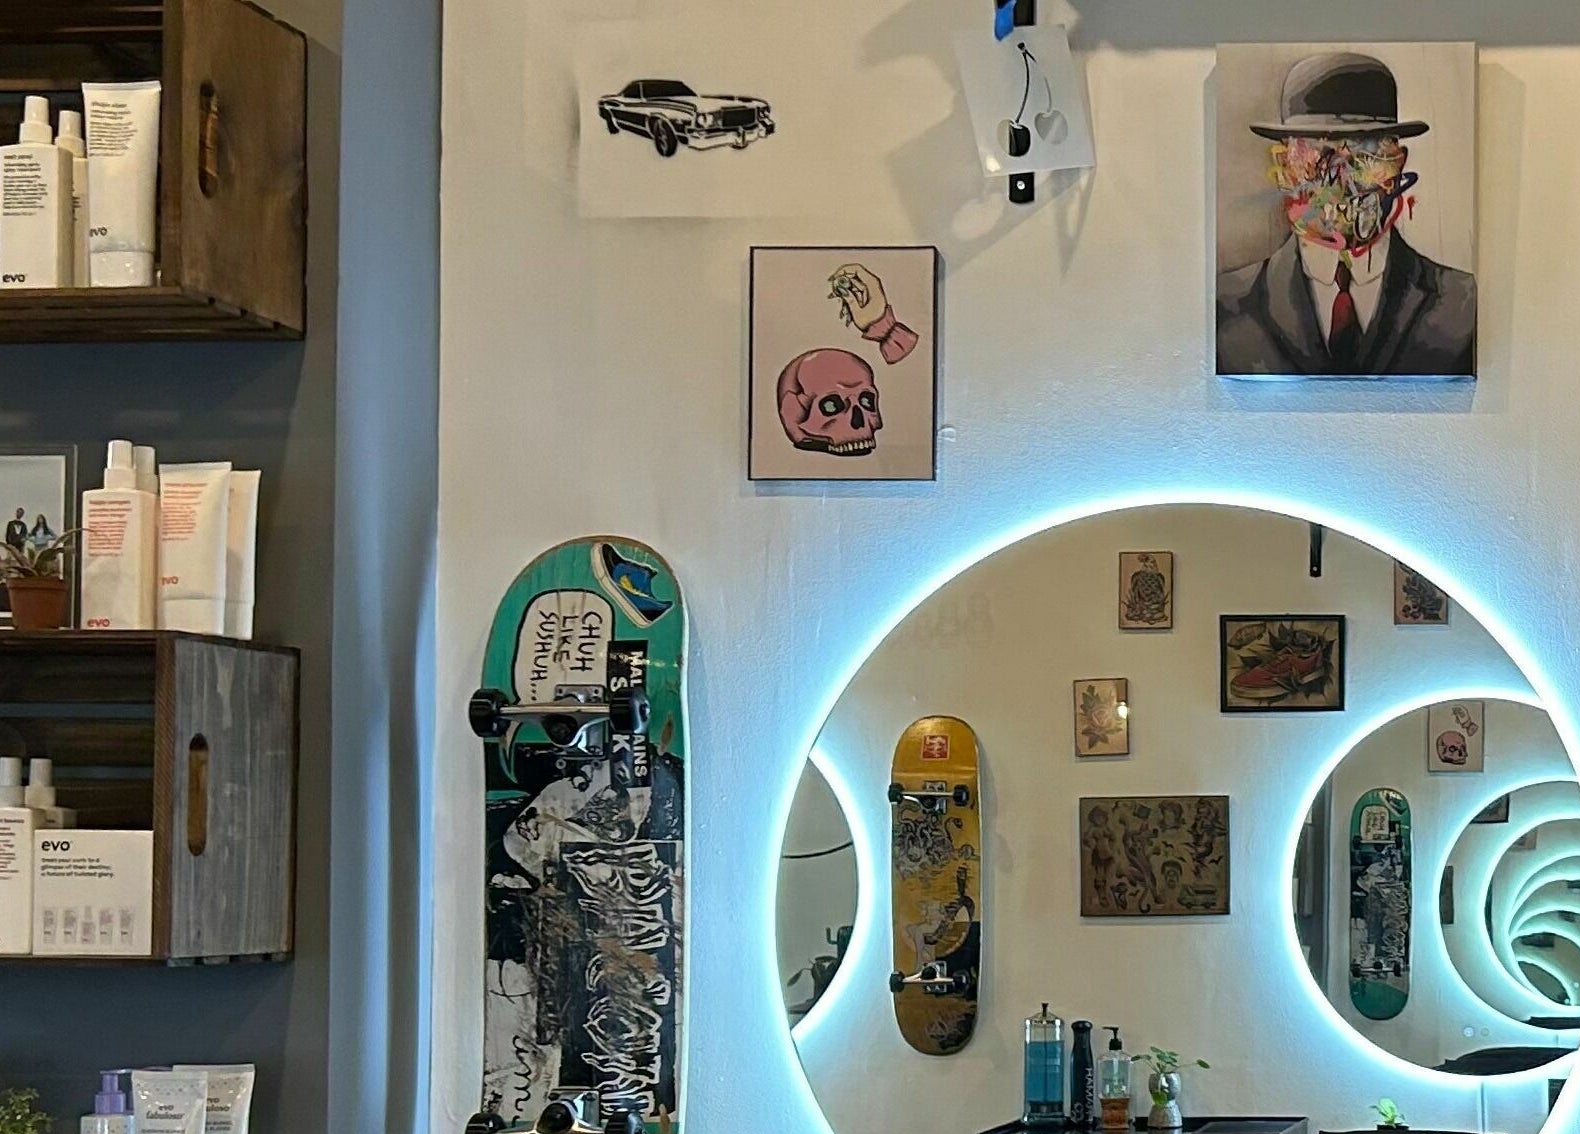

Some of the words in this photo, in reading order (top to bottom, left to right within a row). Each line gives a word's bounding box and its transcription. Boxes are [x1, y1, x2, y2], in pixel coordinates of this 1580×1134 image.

[2, 273, 26, 283] evo
[87, 618, 110, 628] evo
[552, 615, 579, 664] LIKE
[41, 840, 71, 851] evo
